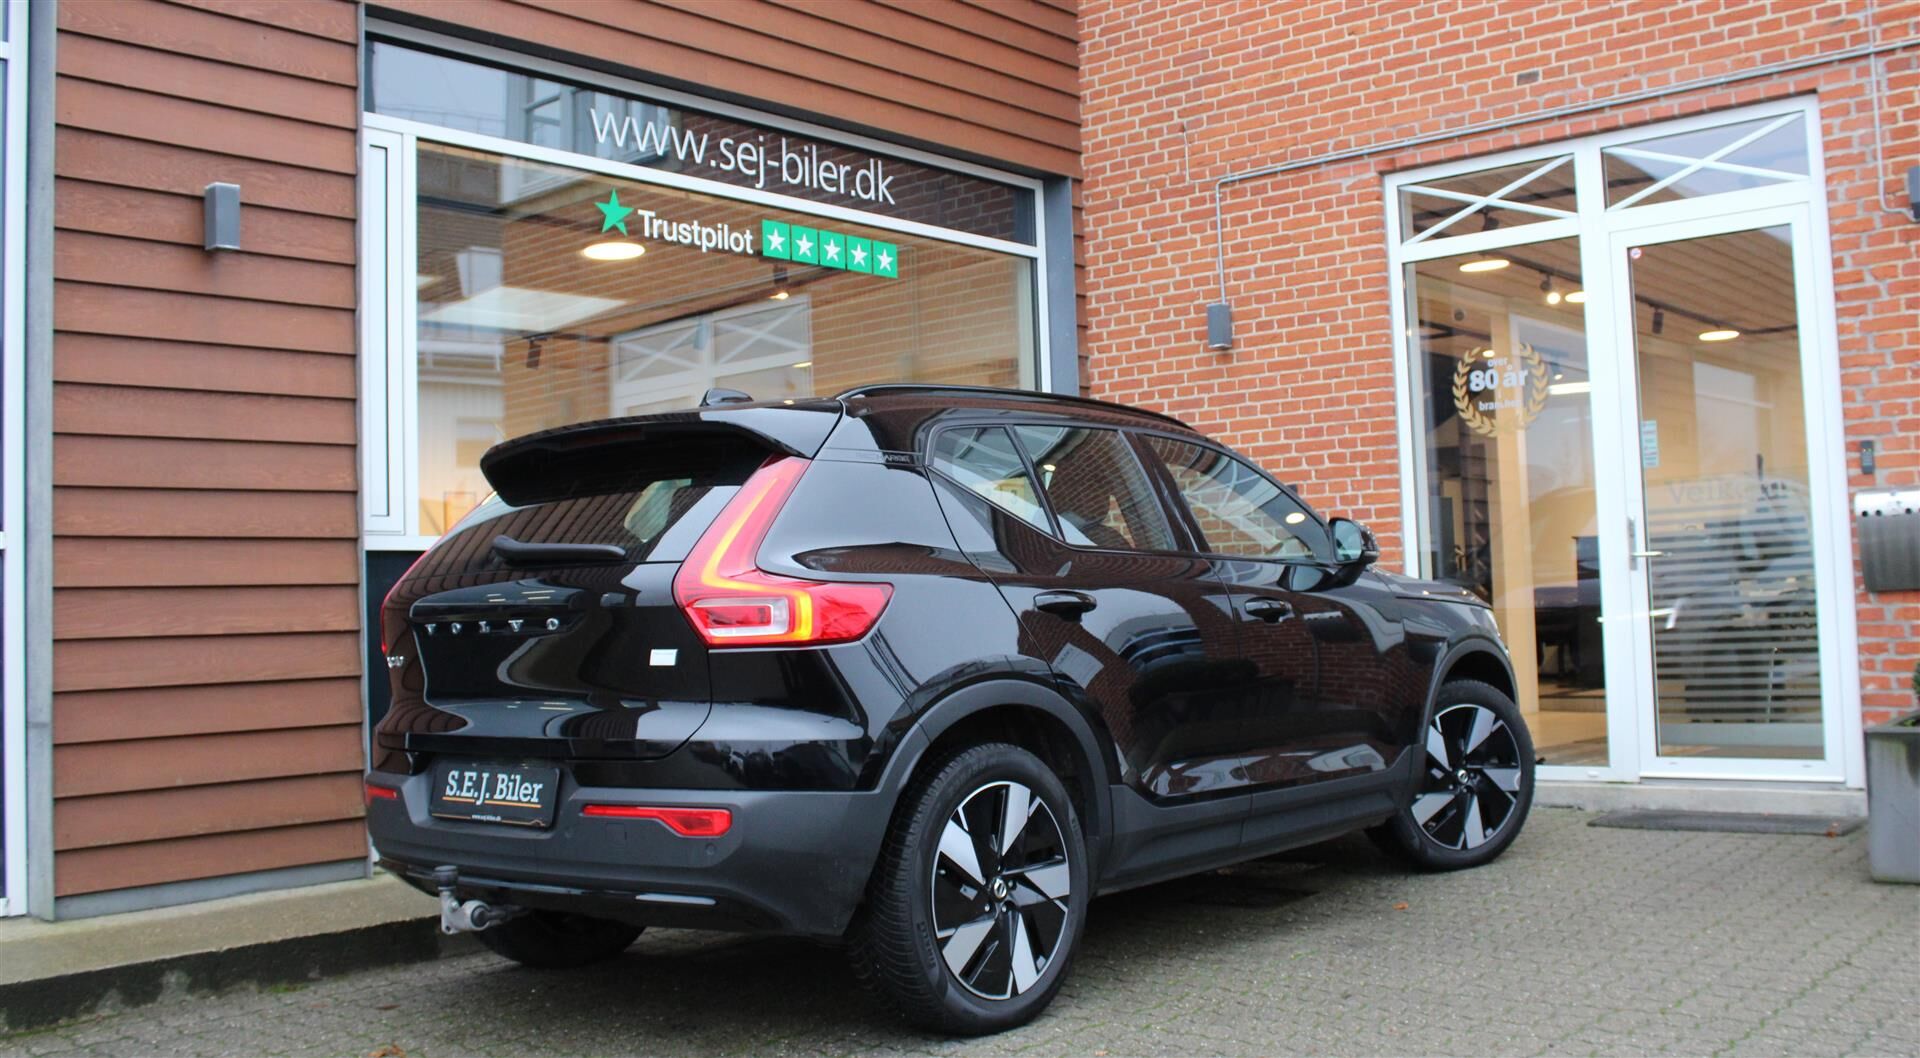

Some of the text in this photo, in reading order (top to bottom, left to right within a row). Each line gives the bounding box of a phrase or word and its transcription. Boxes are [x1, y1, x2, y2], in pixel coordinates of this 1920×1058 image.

[590, 108, 896, 204] www.sej-biler.dk
[638, 209, 754, 254] Trustpilot
[1469, 364, 1528, 392] 80 år
[424, 618, 560, 635] VOLVO
[445, 770, 543, 806] S.E.J. Biler
